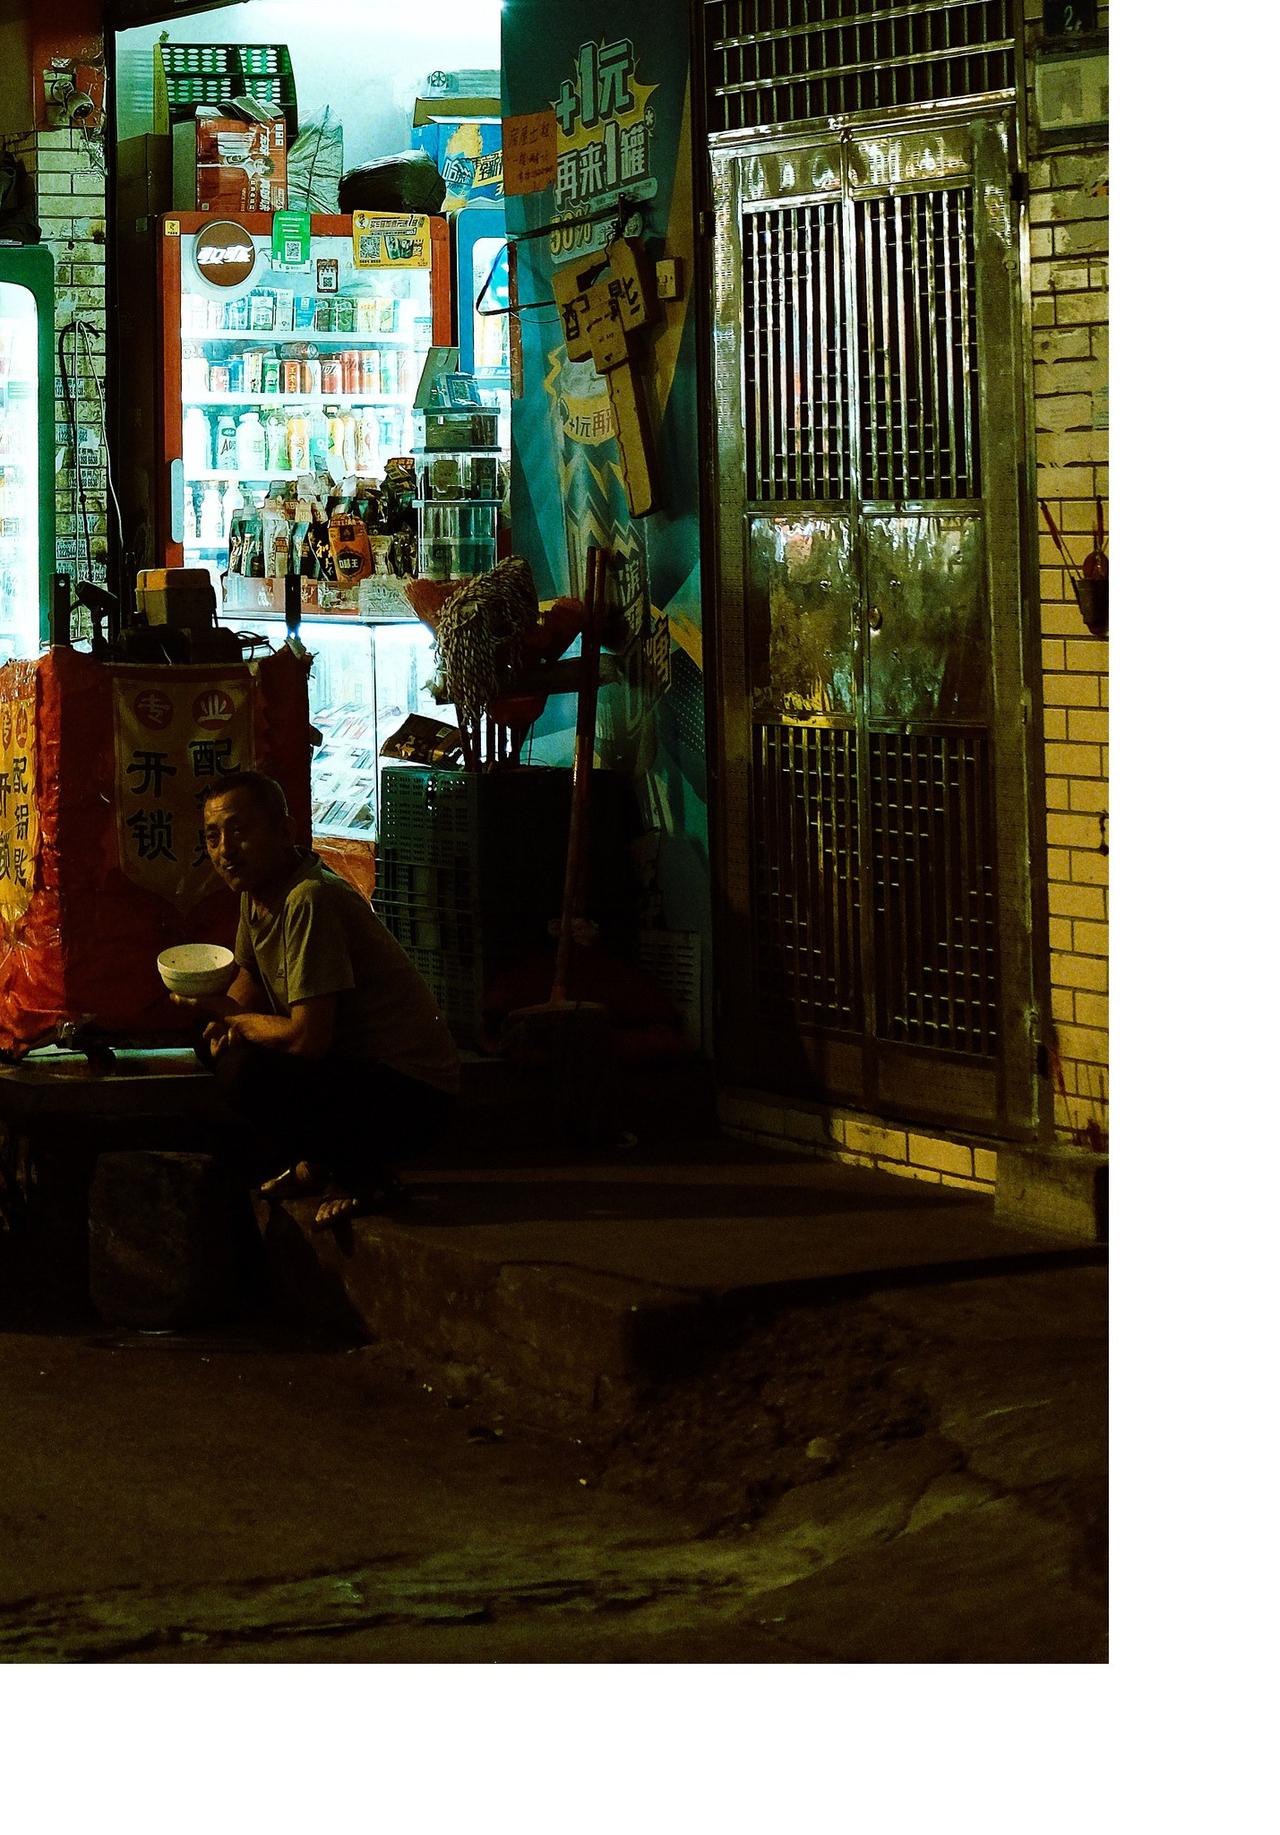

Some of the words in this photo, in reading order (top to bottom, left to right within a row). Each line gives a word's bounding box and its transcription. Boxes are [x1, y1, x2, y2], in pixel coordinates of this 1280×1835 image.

[555, 122, 648, 208] 再来1罐
[126, 750, 177, 863] 开锁
